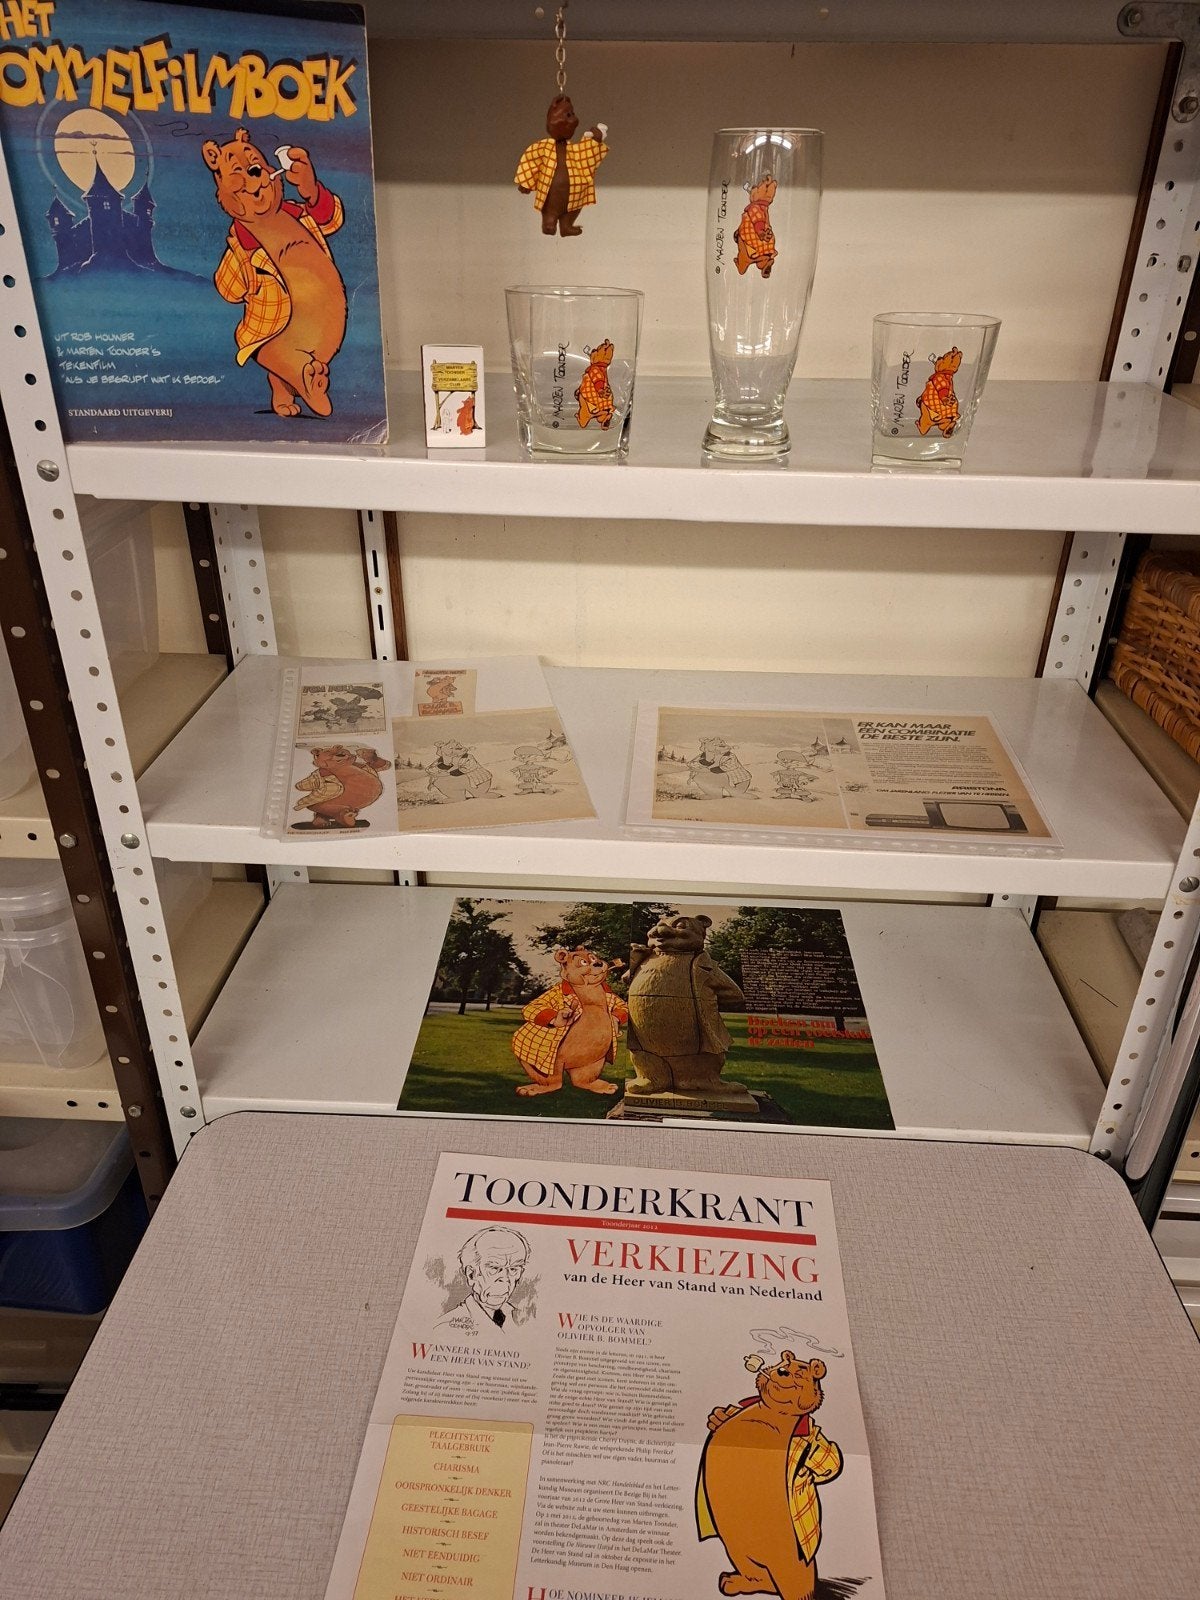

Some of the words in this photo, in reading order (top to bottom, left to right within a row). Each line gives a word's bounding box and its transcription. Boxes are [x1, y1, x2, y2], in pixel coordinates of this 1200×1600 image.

[0, 0, 54, 38] HET
[55, 332, 69, 342] UIT
[70, 332, 92, 341] ROB
[66, 347, 103, 356] MARTEN
[59, 360, 116, 370] TEKENFILM
[86, 375, 98, 384] JE
[151, 375, 170, 384] WAT
[172, 375, 182, 384] IK
[68, 409, 120, 417] STANDAARD
[123, 408, 173, 418] UITGEVERIJ
[454, 1172, 814, 1228] TOONDERKRANT
[566, 1238, 820, 1284] VERKIEZING
[563, 1273, 587, 1283] van
[591, 1272, 608, 1284] de
[612, 1274, 645, 1288] Heer
[650, 1279, 673, 1290] van
[677, 1279, 716, 1294] Stand
[720, 1285, 745, 1296] van
[750, 1284, 823, 1301] Nederland
[602, 1316, 615, 1324] DE
[616, 1317, 664, 1328] WAARDIGE
[577, 1324, 626, 1335] OPVOLGER
[628, 1328, 645, 1336] VAN
[557, 1331, 594, 1342] OLIVIER
[472, 1348, 480, 1356] IS
[483, 1347, 520, 1359] IEMAND
[430, 1354, 448, 1363] EEN
[450, 1355, 475, 1365] HEER
[478, 1358, 494, 1367] VAN
[497, 1360, 532, 1370] STAND?
[429, 1430, 495, 1443] PLECHTSTATIG
[431, 1441, 490, 1453] TAALGEBRUIK
[433, 1462, 480, 1474] CHARISMA
[395, 1480, 473, 1496] OORSPRONKELIJK
[475, 1487, 512, 1498] DENKER
[401, 1503, 460, 1517] GEESTELIJKE
[461, 1508, 498, 1519] BAGAGE
[402, 1526, 460, 1539] HISTORISCH
[461, 1530, 490, 1541] BESEF
[402, 1548, 426, 1559] NIET
[427, 1550, 480, 1563] EENDUIDIG
[401, 1571, 425, 1582] NIET
[426, 1573, 473, 1587] ORDINAIR
